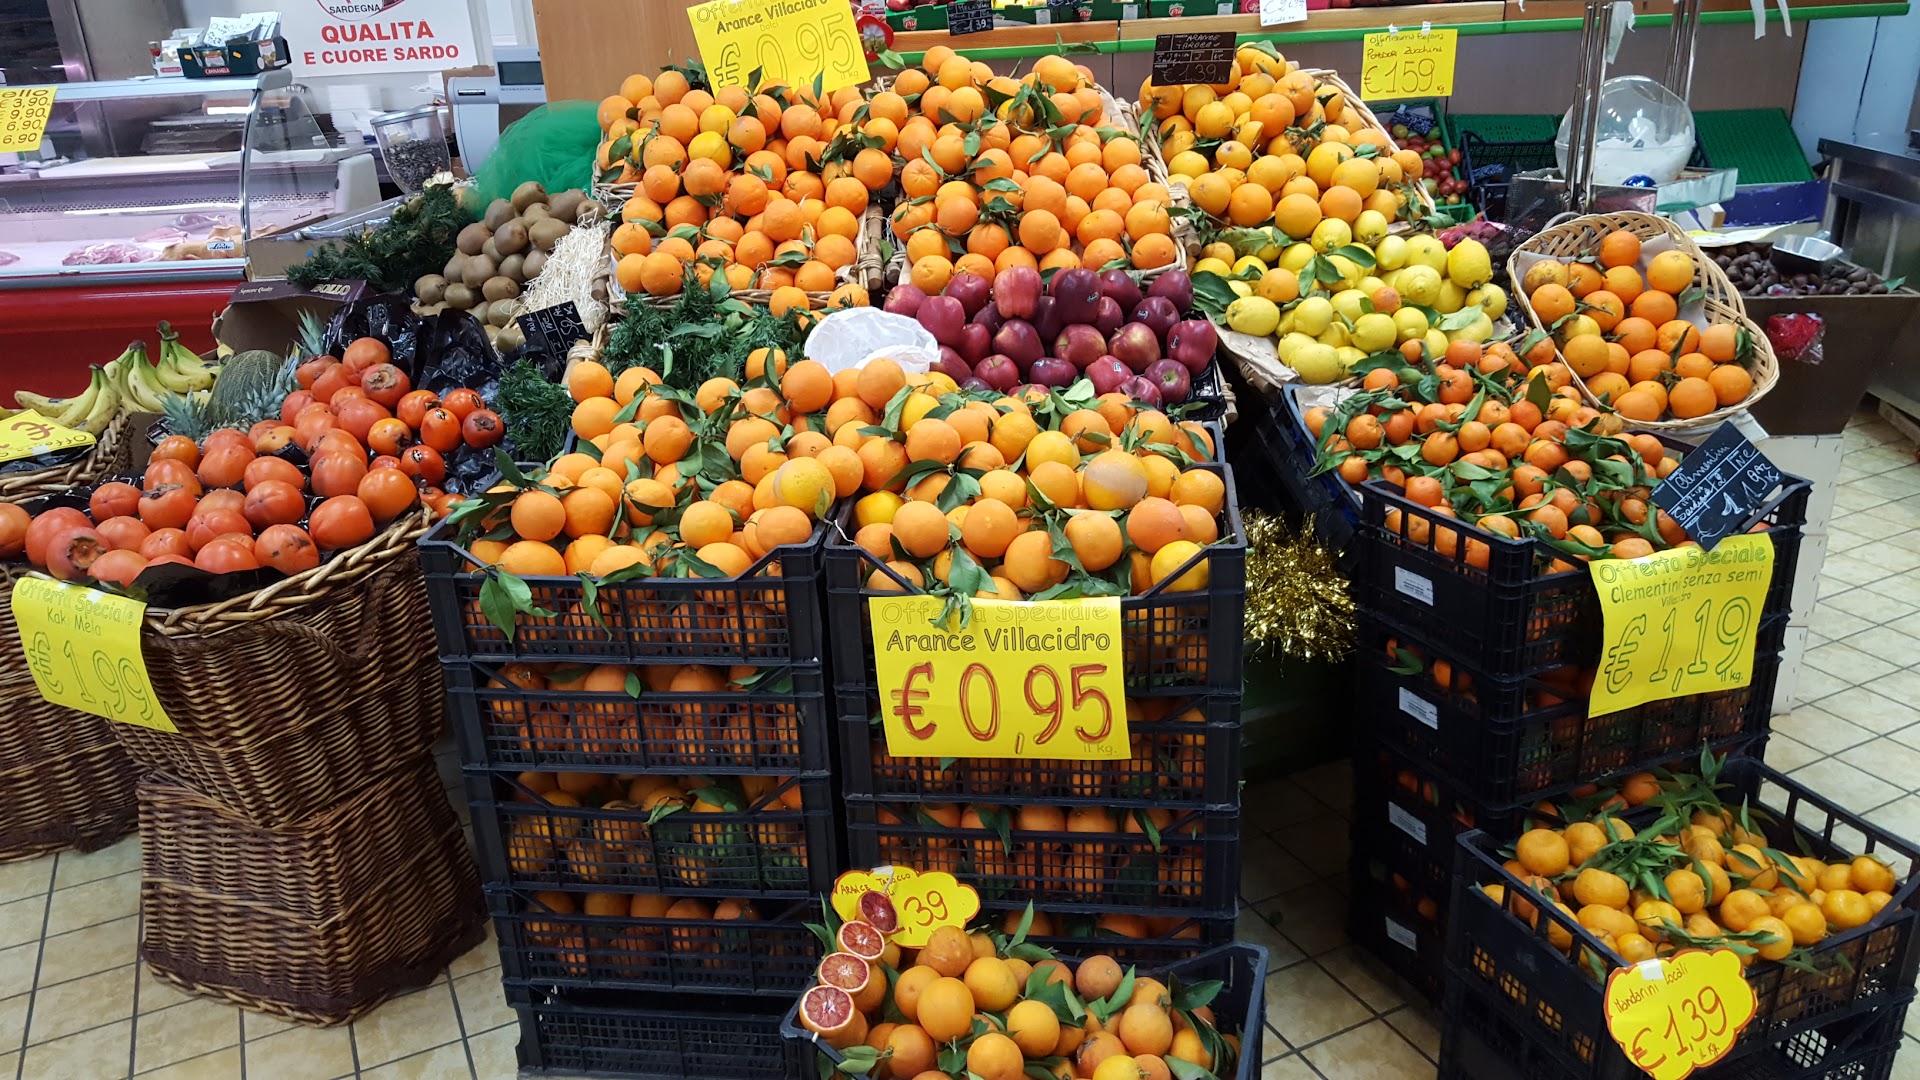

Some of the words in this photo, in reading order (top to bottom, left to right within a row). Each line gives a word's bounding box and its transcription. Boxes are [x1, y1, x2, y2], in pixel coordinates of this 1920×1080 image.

[329, 4, 381, 14] SARDEGNA
[716, 13, 763, 34] Arance
[760, 22, 779, 32] Dolci
[304, 52, 316, 65] E
[322, 49, 388, 64] CUORE
[394, 45, 459, 60] SARDO
[714, 42, 741, 88] €
[13, 97, 48, 108] 3,90
[10, 108, 45, 120] 9,90
[6, 120, 41, 131] 6,90
[3, 133, 37, 144] 6,90
[1600, 556, 1681, 584] Offerta
[1687, 541, 1767, 573] Speciale
[1611, 576, 1681, 604] Clementini
[1682, 569, 1721, 589] senza
[1726, 565, 1764, 583] semi
[75, 594, 134, 626] Speciale
[882, 601, 987, 625] Offea
[996, 601, 1109, 627] Speciale
[75, 614, 102, 637] Mela
[886, 629, 976, 651] Arance
[984, 626, 1110, 651] Villacidro
[841, 883, 871, 895] ARANCE
[876, 873, 911, 887] TAOCCO
[1614, 979, 1659, 1013] Mandarini
